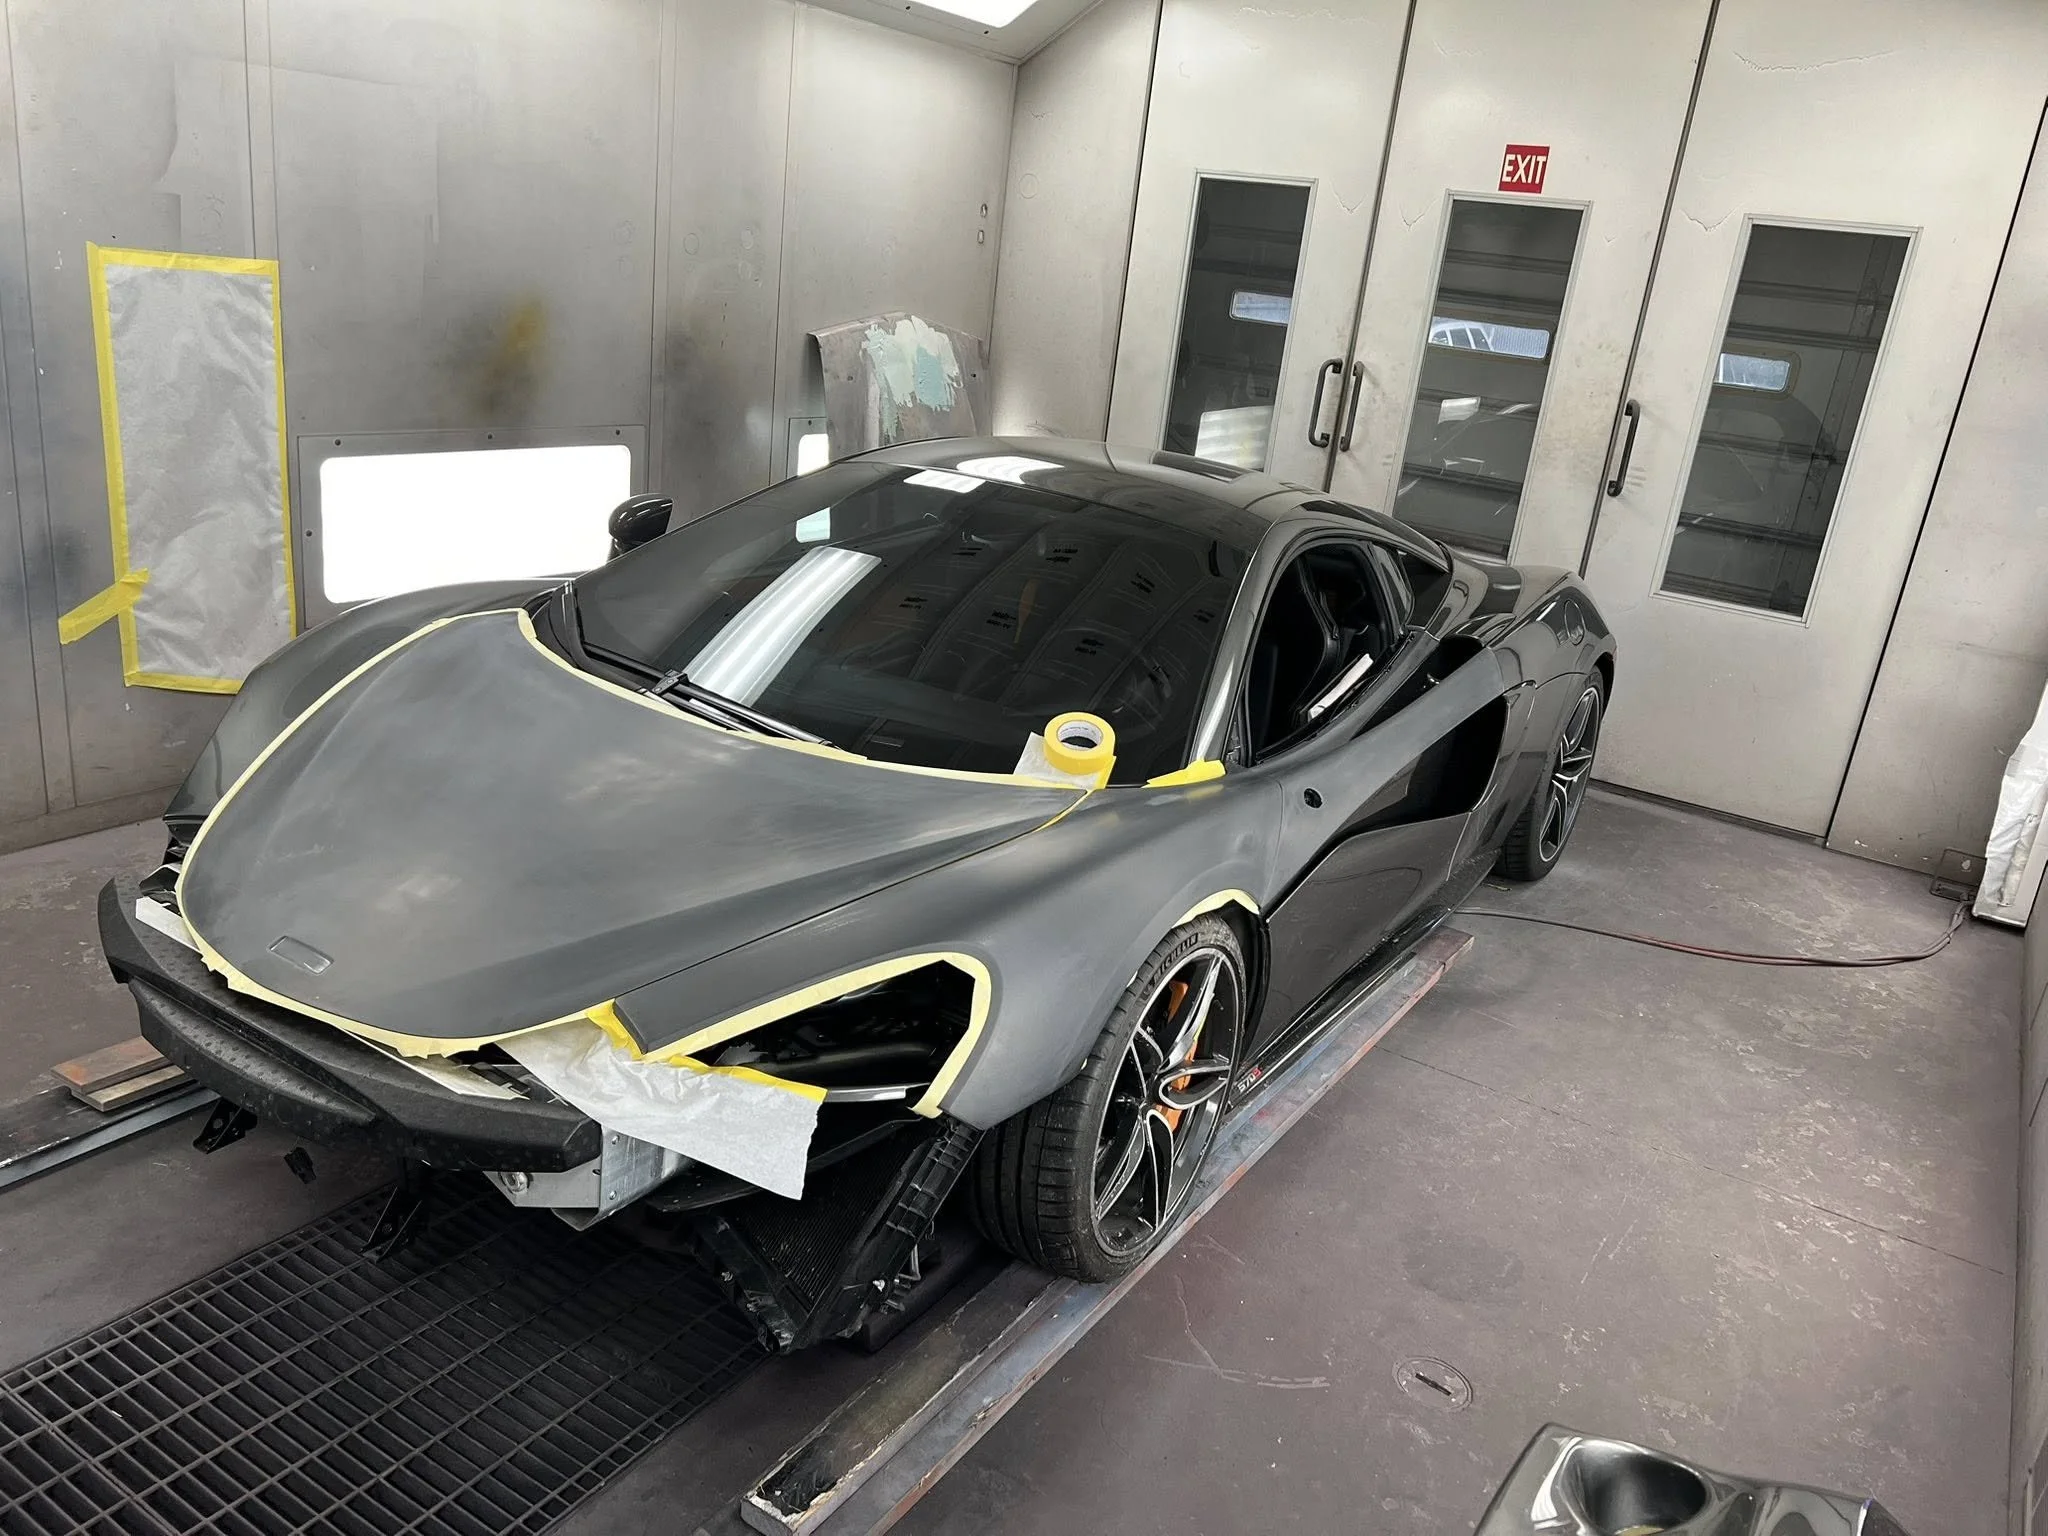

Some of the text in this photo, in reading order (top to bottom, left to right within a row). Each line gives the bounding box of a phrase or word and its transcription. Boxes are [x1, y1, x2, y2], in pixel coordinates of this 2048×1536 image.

[1501, 153, 1547, 184] EXIT
[1151, 932, 1199, 986] MICHELIN
[1238, 1066, 1262, 1092] 570S
